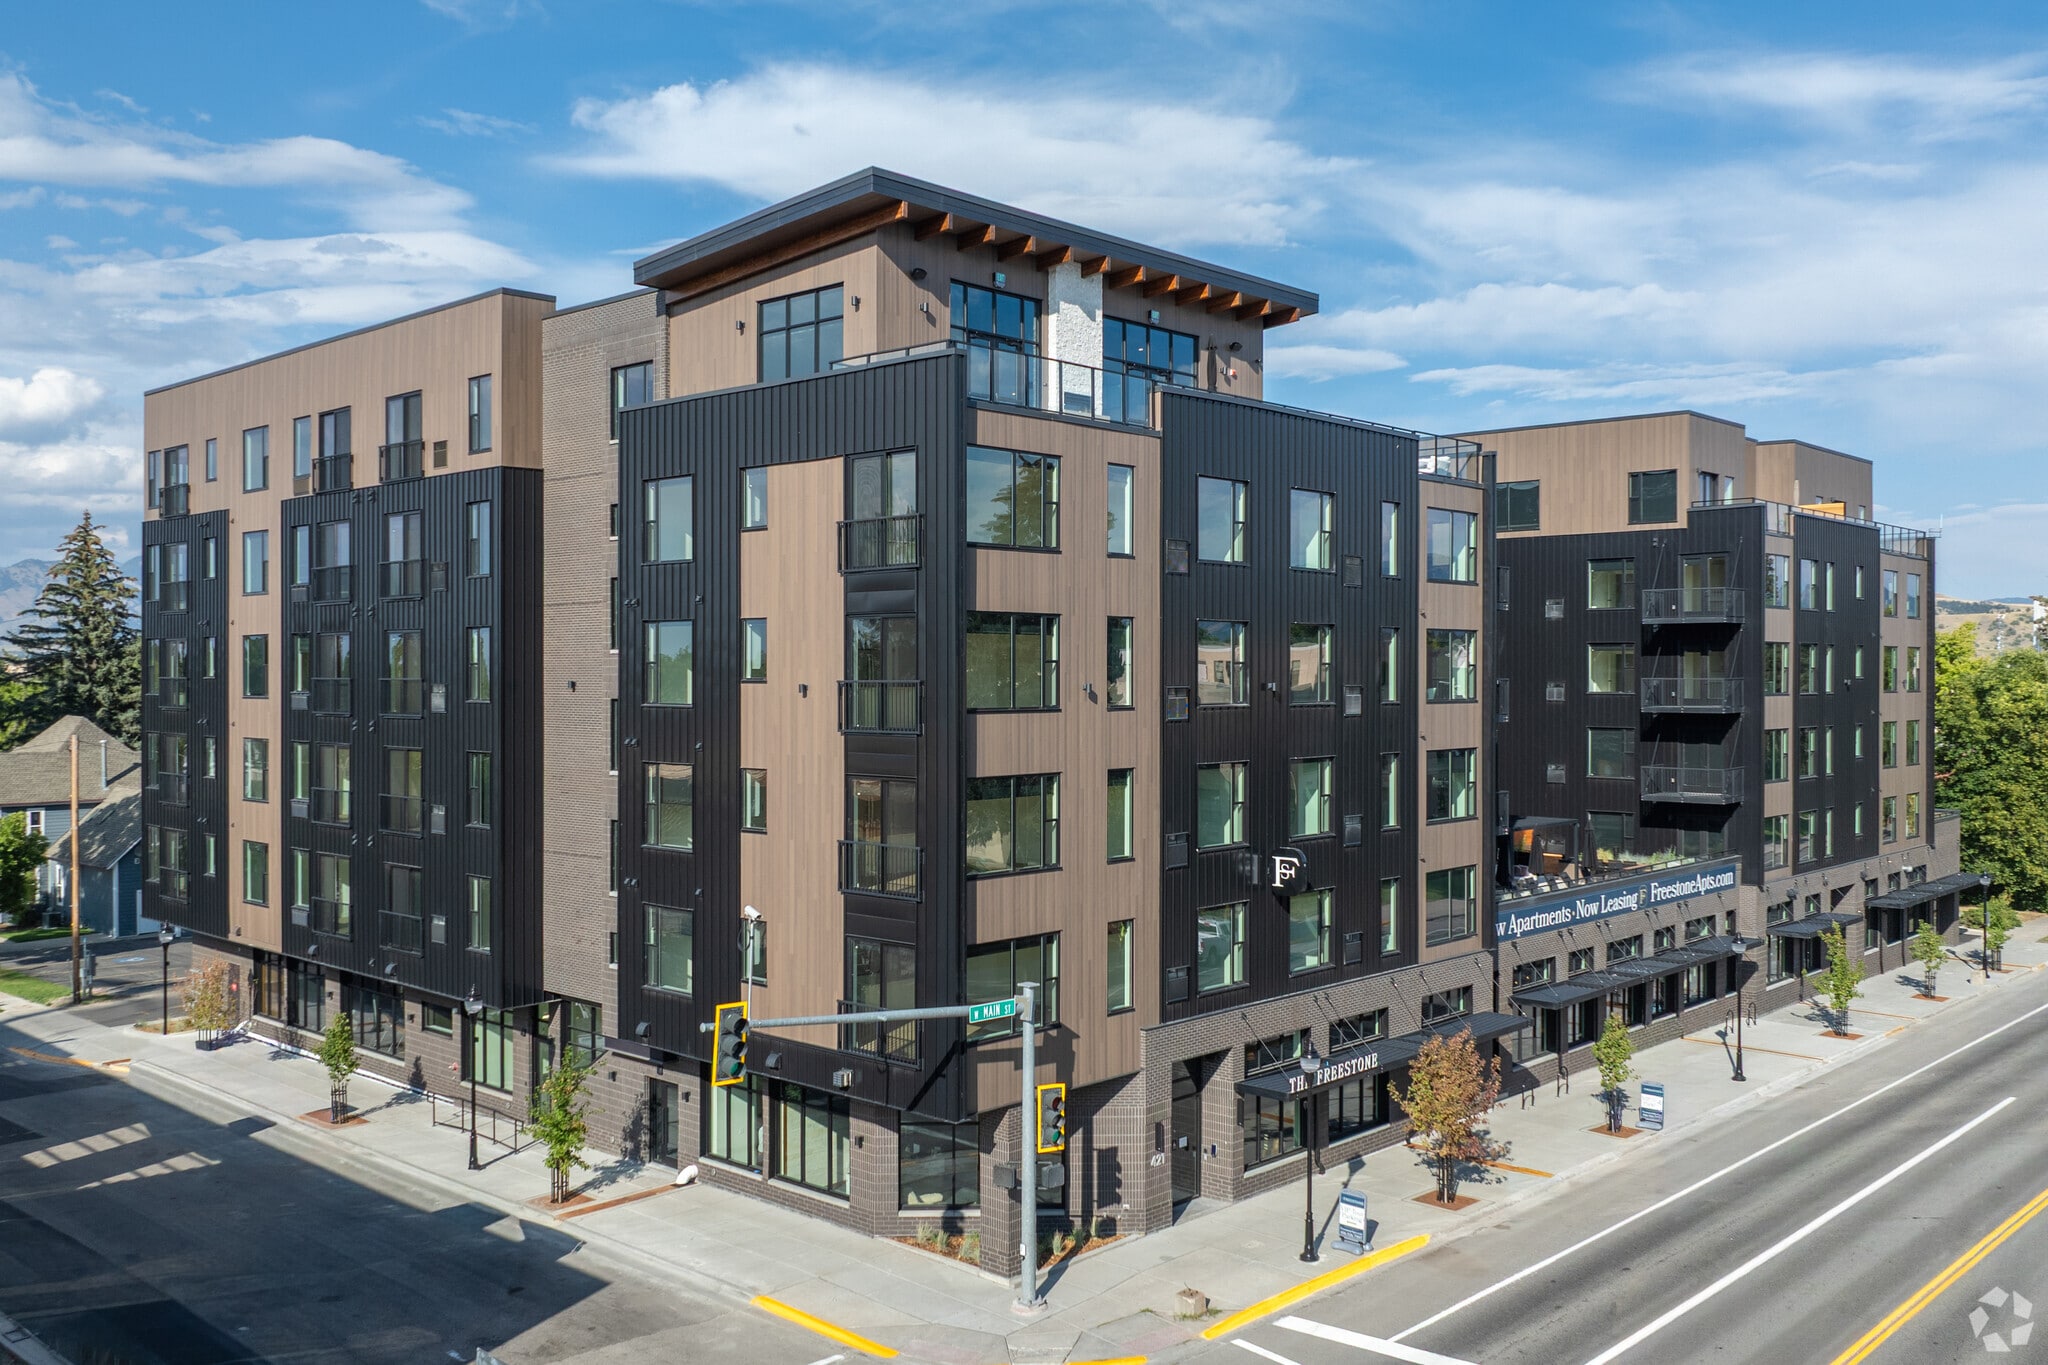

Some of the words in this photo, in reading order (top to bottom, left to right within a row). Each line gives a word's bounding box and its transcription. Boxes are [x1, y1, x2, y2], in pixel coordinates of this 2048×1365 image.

[1508, 906, 1572, 937] Apartments
[1575, 899, 1600, 919] Now
[1600, 890, 1639, 911] Leasing
[1650, 871, 1734, 902] FreestoneApts.com
[974, 1010, 979, 1020] W
[983, 1003, 1000, 1018] MAIN
[1004, 1004, 1011, 1015] ST
[1289, 1074, 1309, 1093] TH
[1316, 1052, 1378, 1086] FREESTONE
